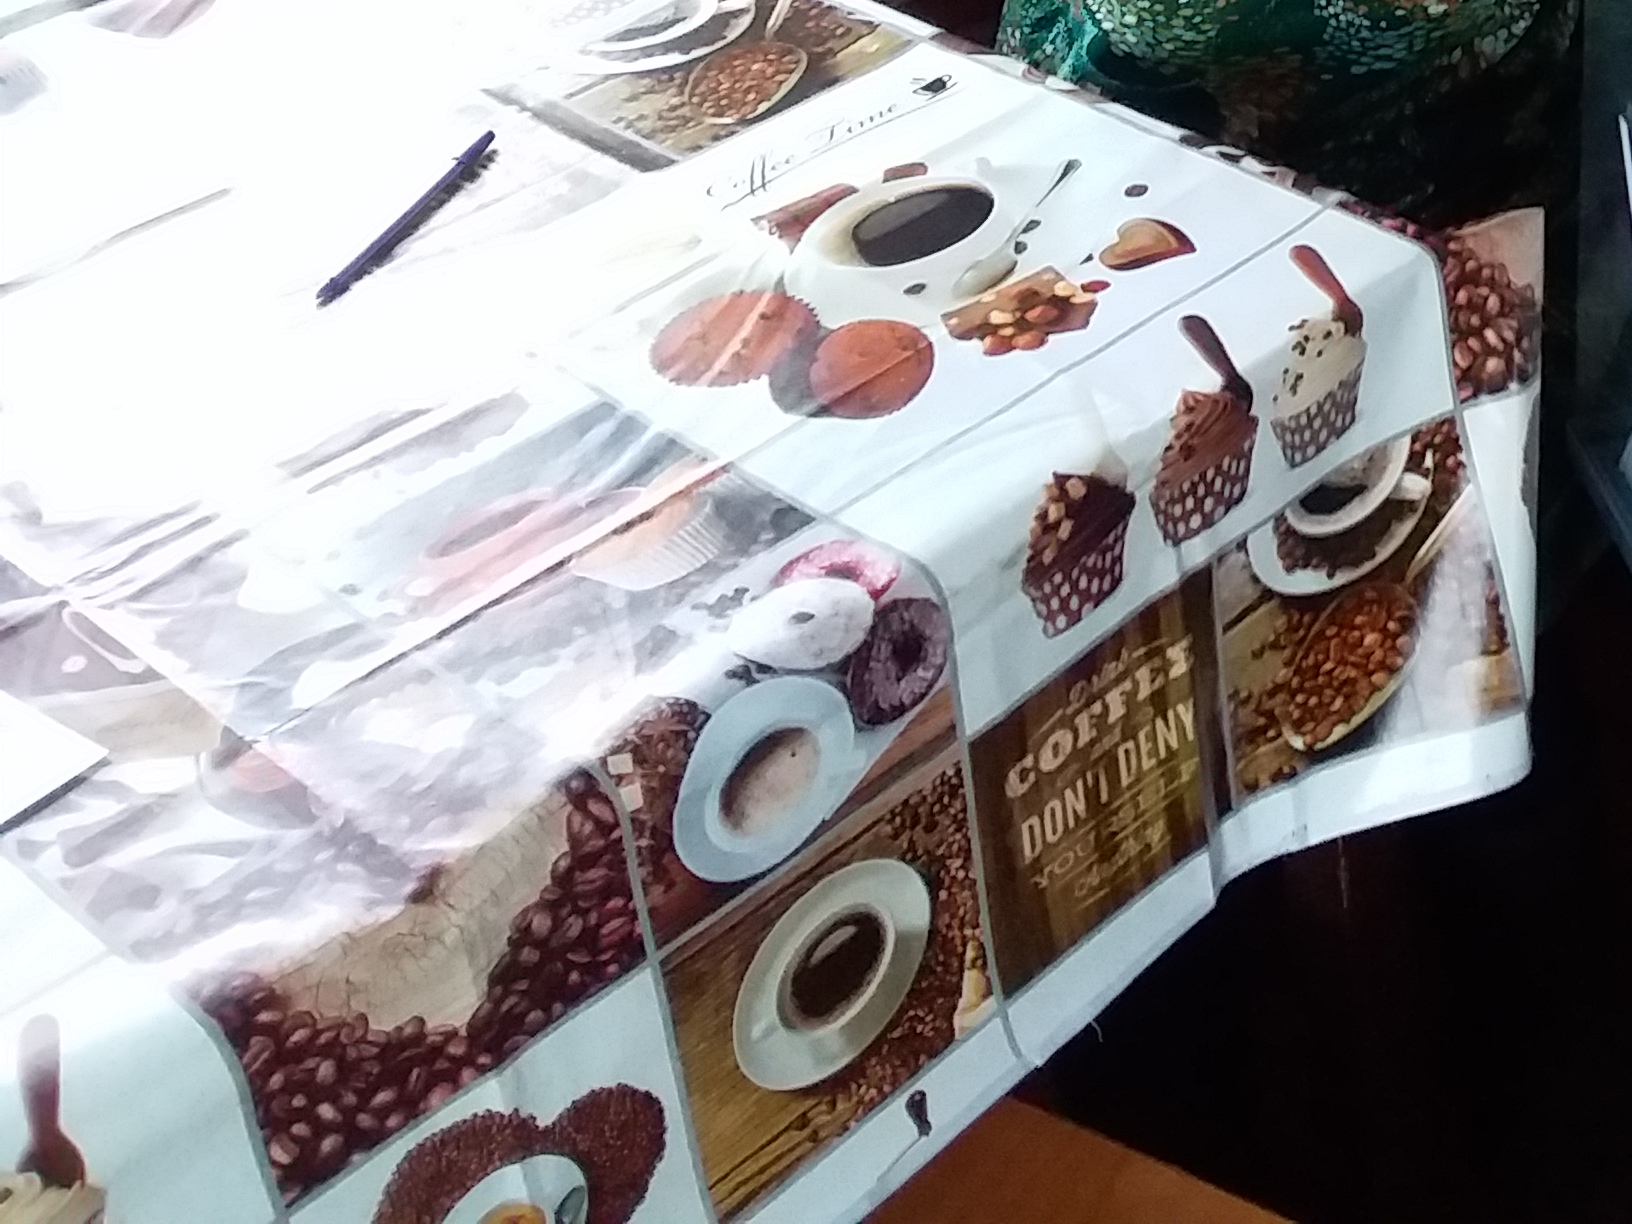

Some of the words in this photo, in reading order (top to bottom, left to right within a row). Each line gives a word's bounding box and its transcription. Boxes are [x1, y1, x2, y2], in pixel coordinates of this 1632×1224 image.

[707, 148, 796, 197] Coffee
[806, 103, 898, 153] Time
[1021, 767, 1108, 864] DON'T
[1117, 698, 1194, 788] DENY
